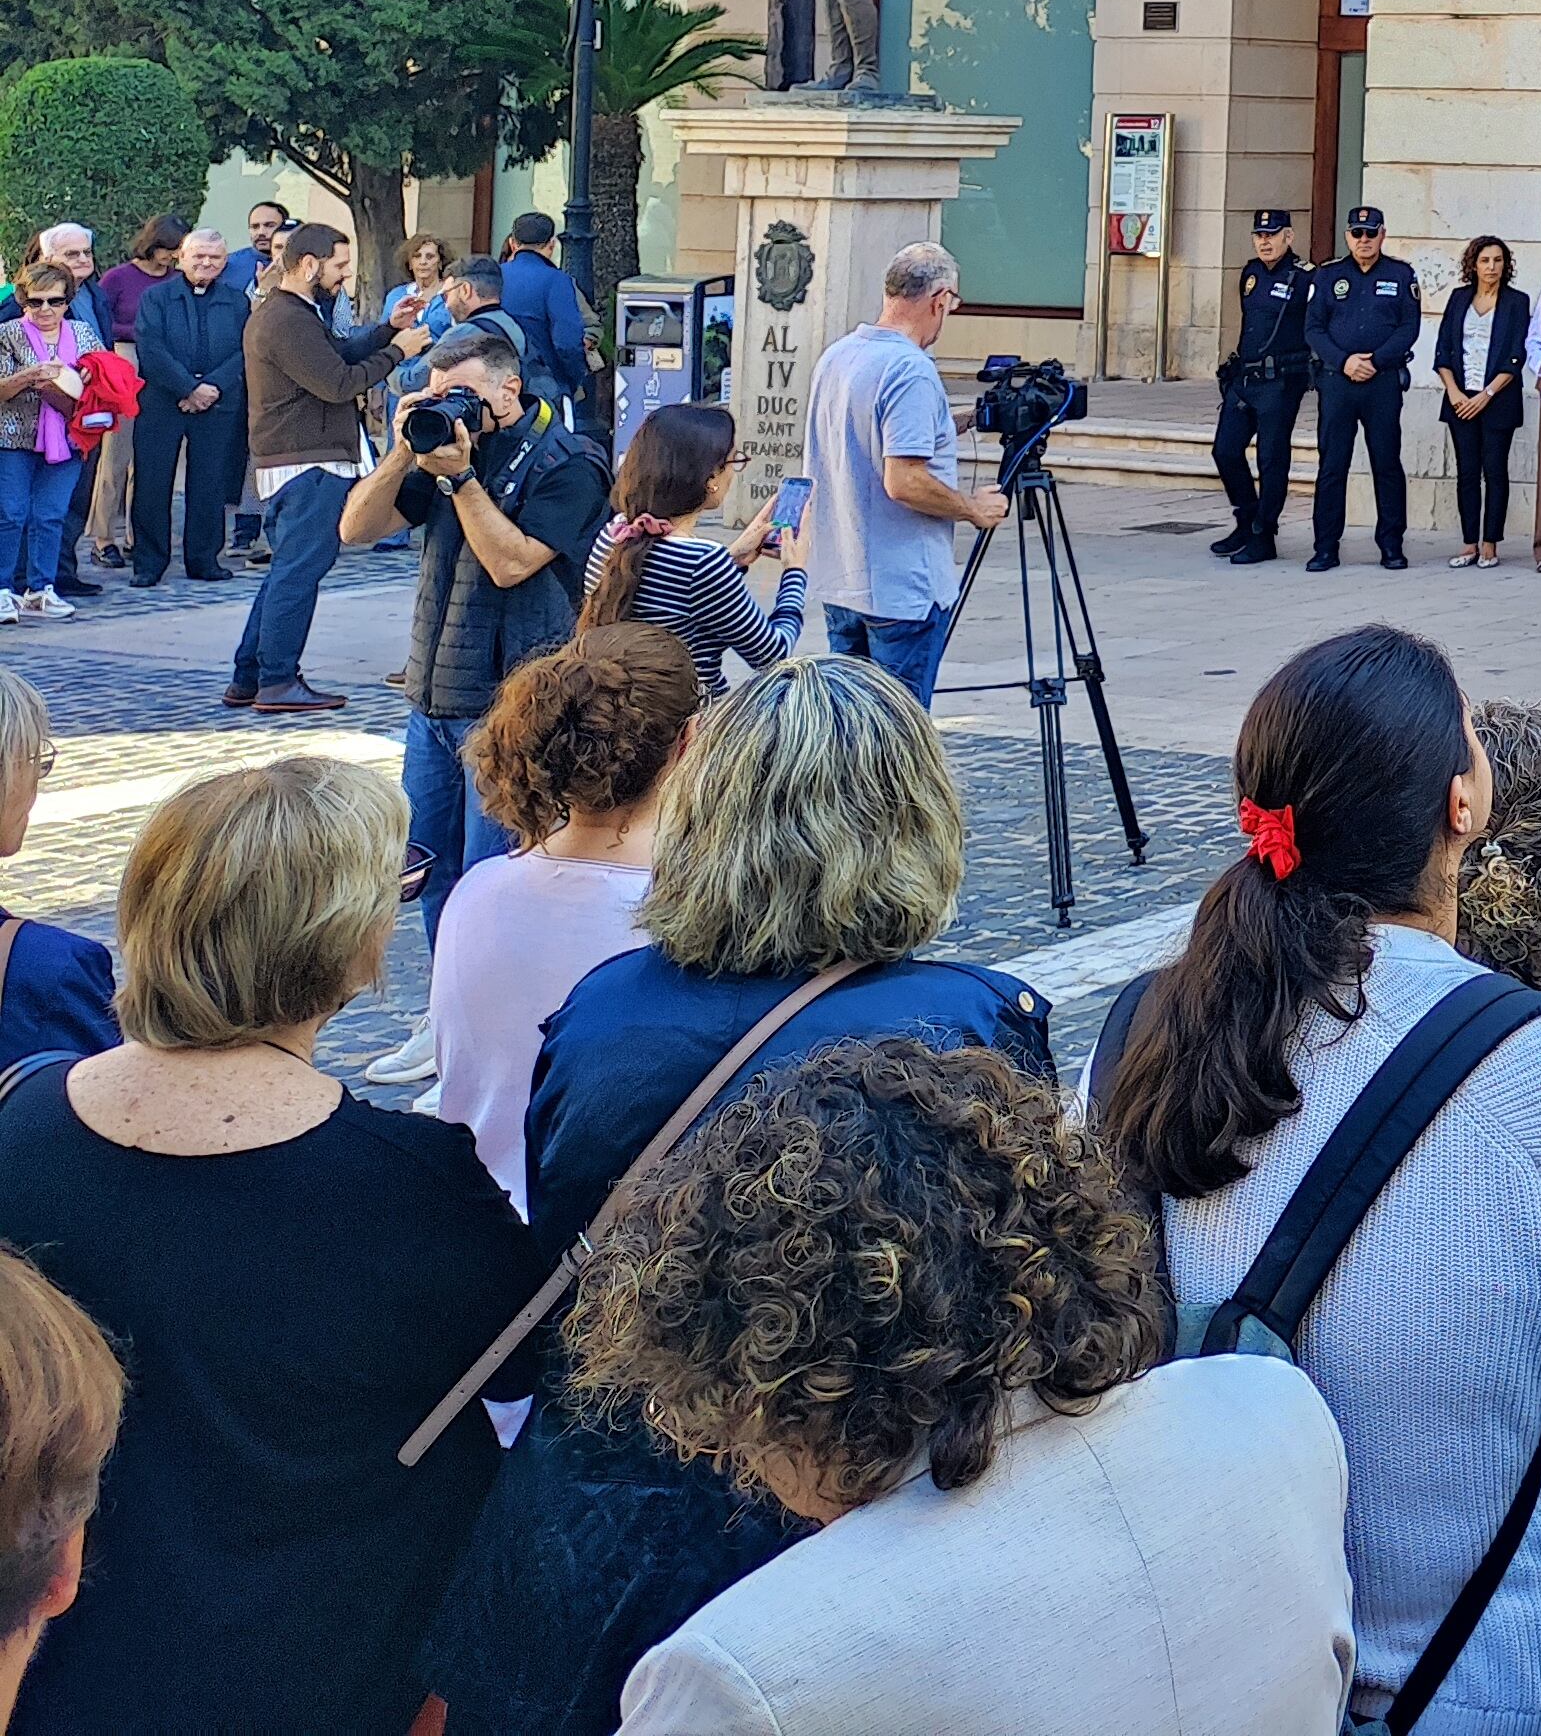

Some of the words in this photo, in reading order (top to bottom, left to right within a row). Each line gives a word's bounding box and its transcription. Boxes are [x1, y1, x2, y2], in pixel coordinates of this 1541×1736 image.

[761, 325, 799, 354] AL
[766, 360, 797, 390] IV
[757, 396, 798, 416] DUC
[757, 421, 796, 437] SANT
[743, 441, 803, 458] FRANCES
[764, 463, 784, 479] DE
